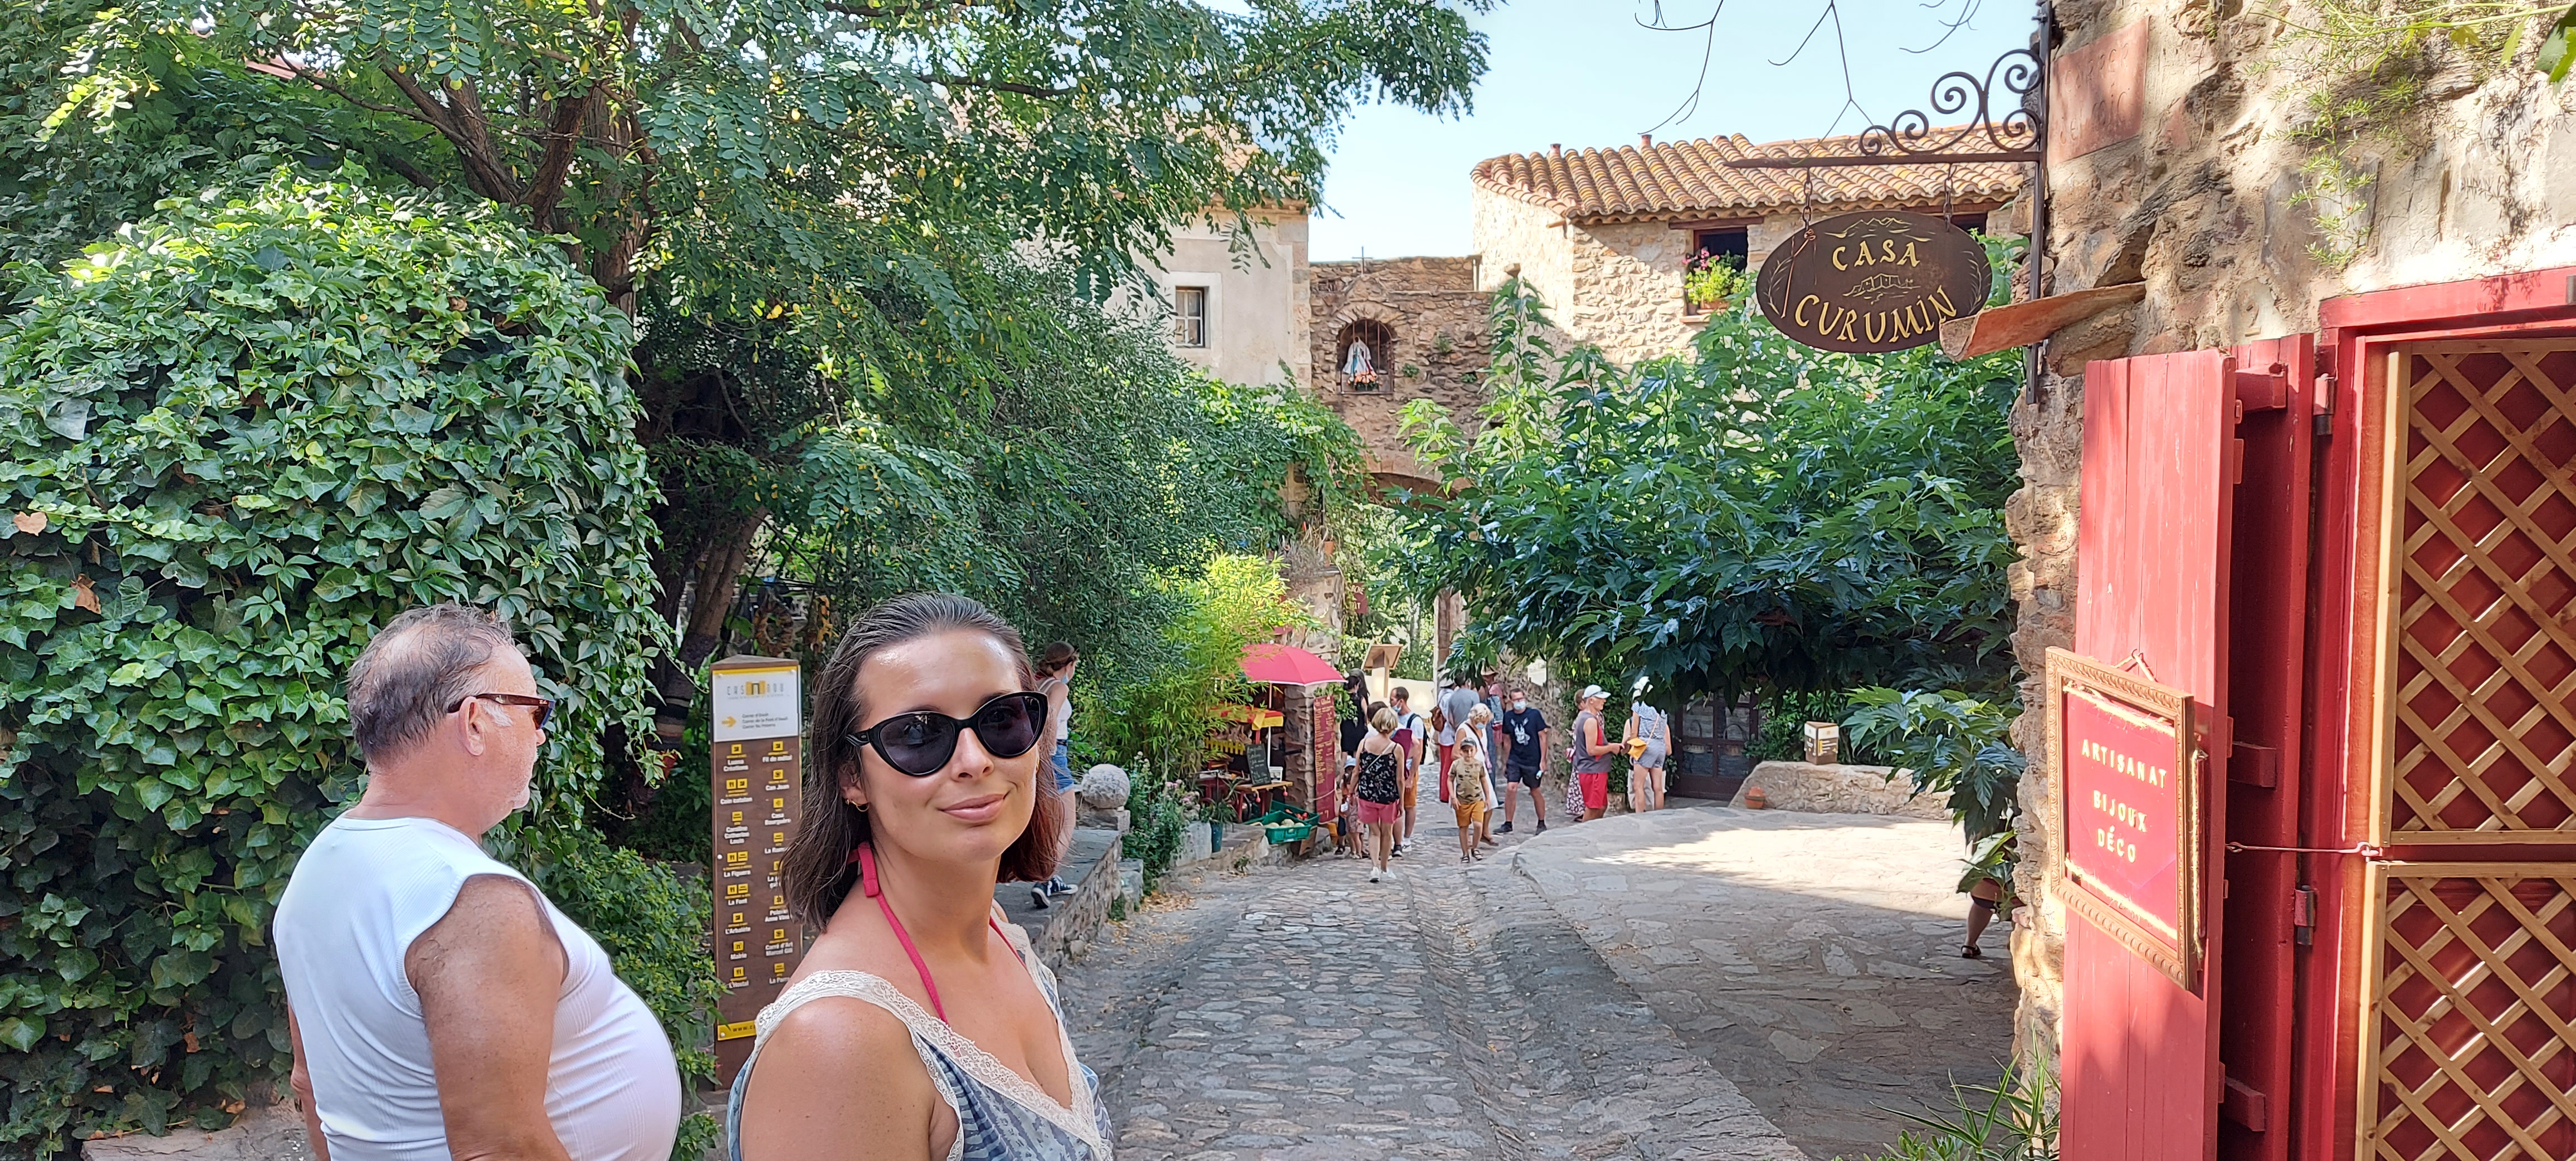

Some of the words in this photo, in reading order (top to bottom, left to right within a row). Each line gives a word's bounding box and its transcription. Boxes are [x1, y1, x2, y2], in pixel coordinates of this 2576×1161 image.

[1832, 239, 1920, 271] CASA
[2082, 739, 2167, 788] ARTISANAT
[2094, 790, 2147, 832] BIJOUX
[2097, 826, 2135, 862] DÉCO
